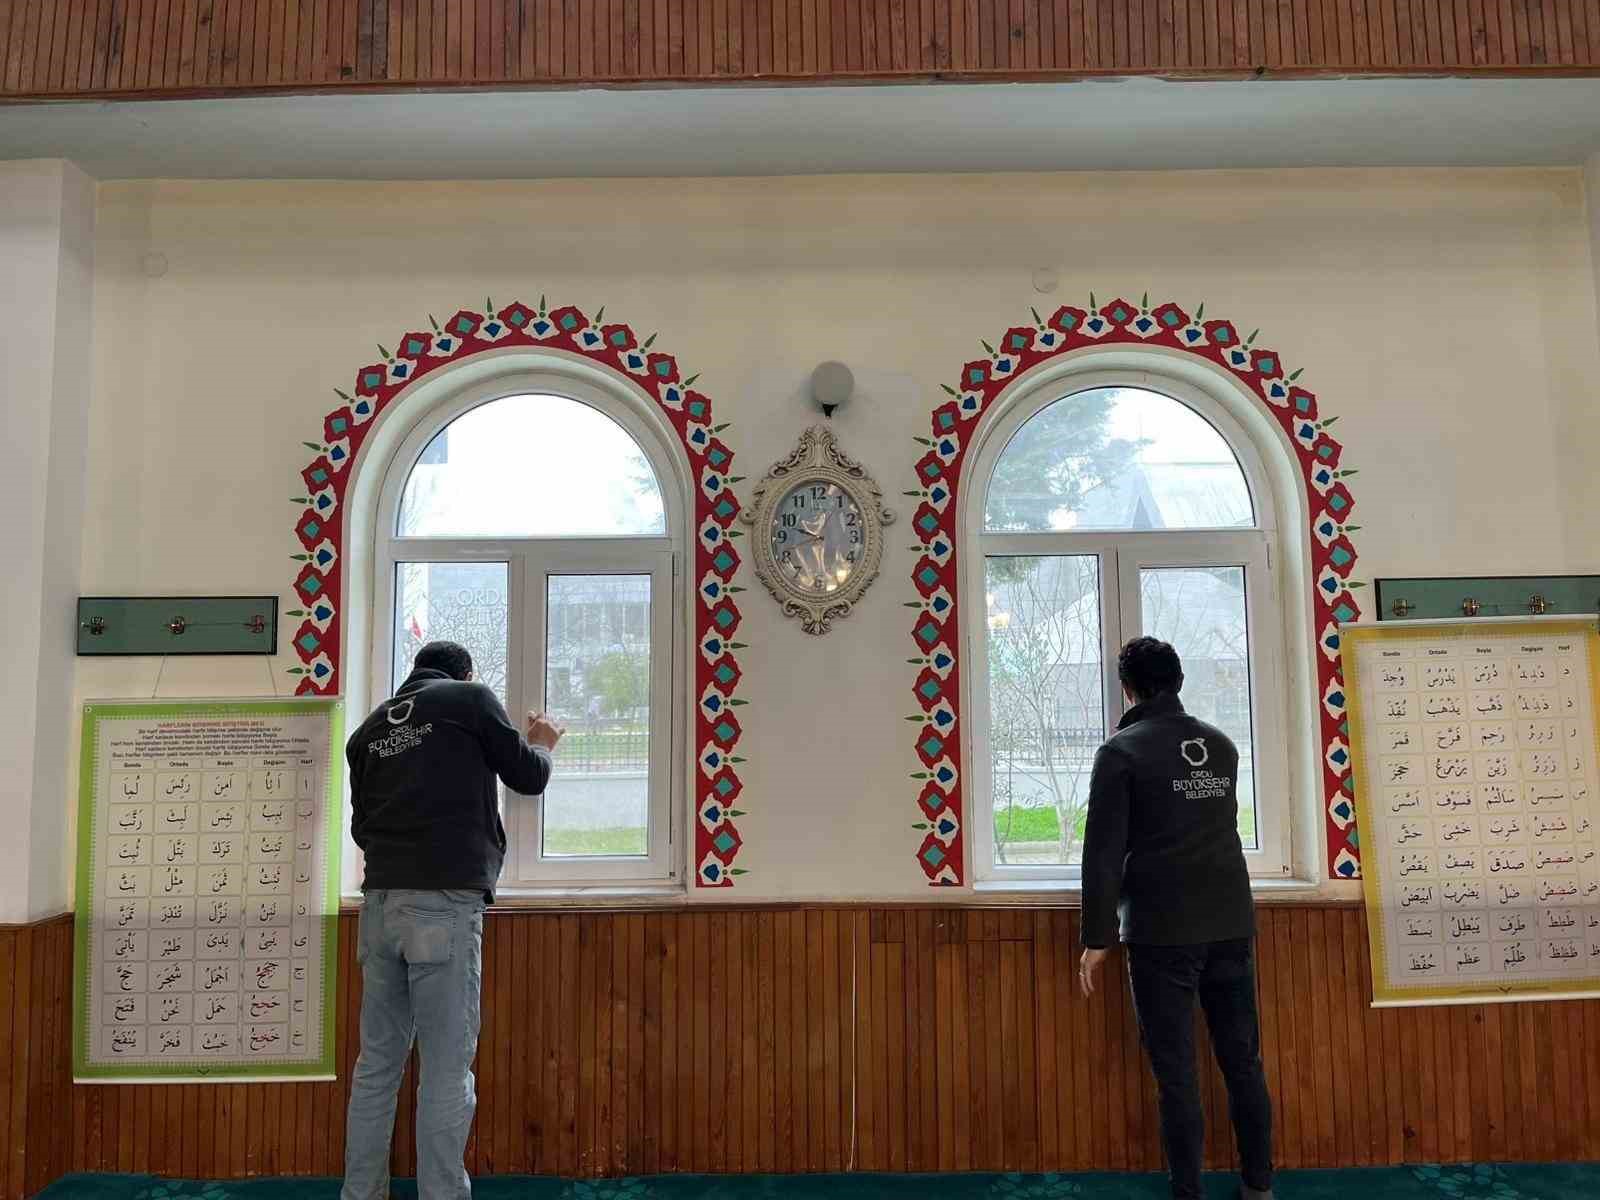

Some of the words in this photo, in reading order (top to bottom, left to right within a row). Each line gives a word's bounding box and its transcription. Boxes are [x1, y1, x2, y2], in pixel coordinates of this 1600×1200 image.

[810, 486, 826, 500] 12
[793, 496, 805, 508] 11
[837, 496, 843, 508] 1
[782, 513, 797, 528] 10
[847, 513, 856, 527] 2
[777, 530, 787, 544] 9
[850, 530, 859, 544] 3
[847, 551, 855, 564] 4
